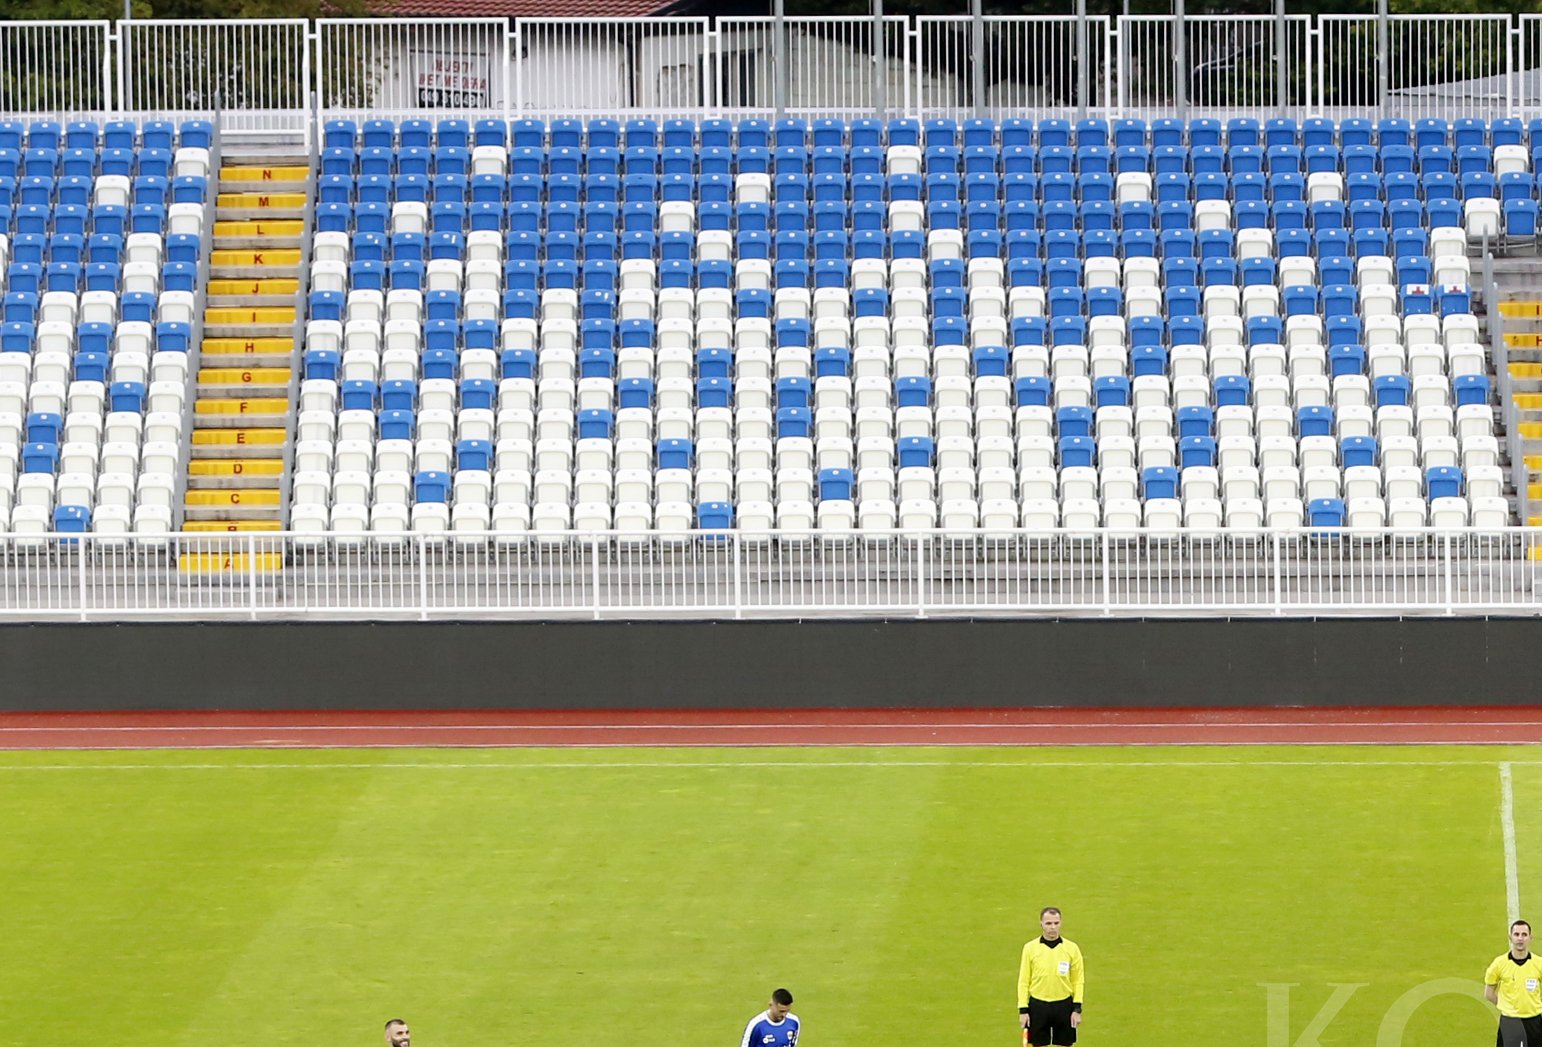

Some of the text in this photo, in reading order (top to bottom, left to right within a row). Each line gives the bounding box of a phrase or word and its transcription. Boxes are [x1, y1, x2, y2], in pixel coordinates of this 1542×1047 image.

[263, 170, 273, 181] N
[259, 197, 271, 208] M
[257, 226, 264, 235] L
[254, 255, 265, 266] K
[252, 285, 259, 295] J
[245, 343, 256, 354] H
[241, 373, 252, 384] G
[240, 402, 248, 413] F
[236, 433, 246, 445] E
[233, 463, 243, 475] D
[230, 493, 241, 505] C
